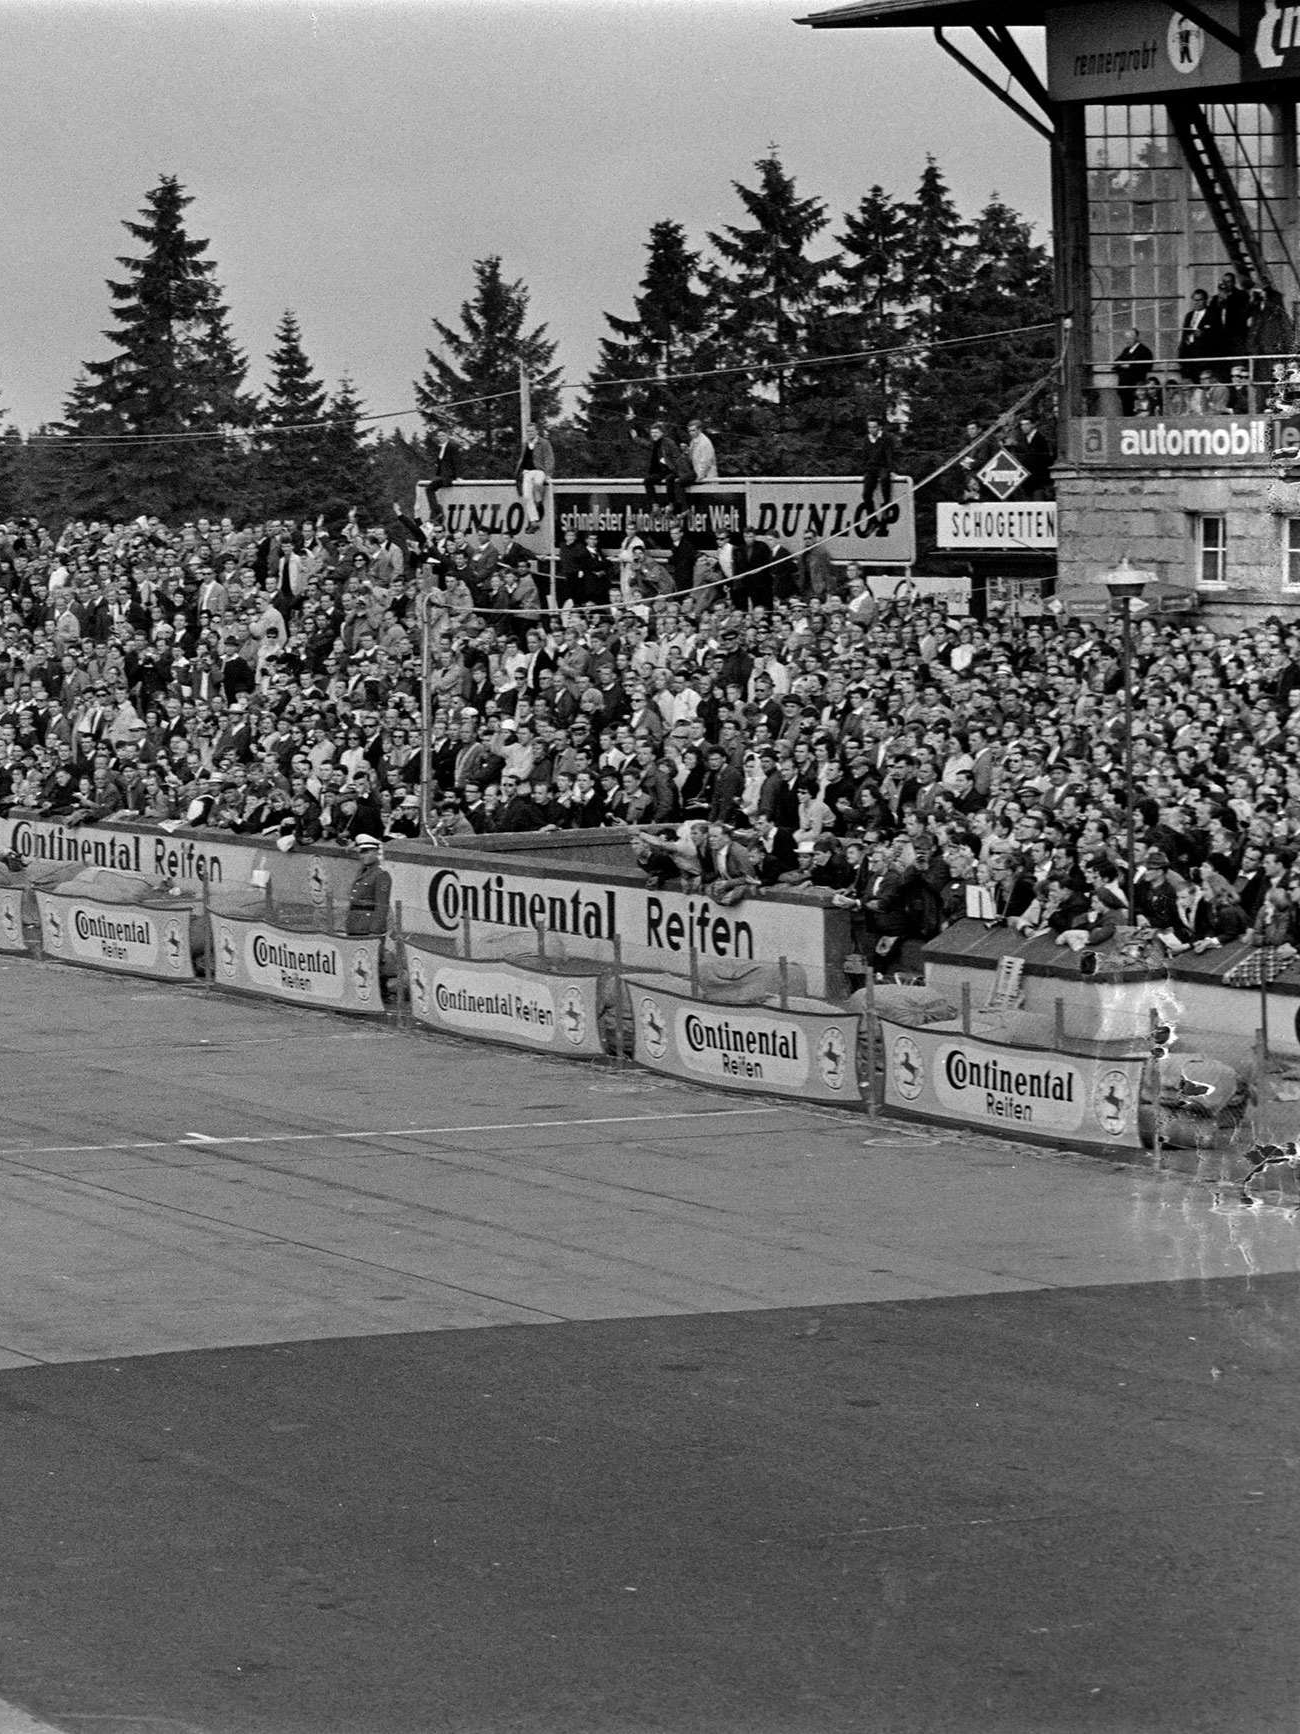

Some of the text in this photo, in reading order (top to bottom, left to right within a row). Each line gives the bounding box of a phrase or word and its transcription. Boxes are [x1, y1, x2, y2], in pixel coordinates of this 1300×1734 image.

[446, 502, 545, 538] UNLO
[708, 505, 739, 532] Welt
[753, 502, 900, 539] DUNLOP
[952, 511, 1055, 538] SCHOGETTEN
[11, 821, 223, 884] Continental Reifen
[75, 910, 151, 946] Continental
[428, 870, 754, 960] Continental Reifen
[252, 934, 337, 976] Continental
[281, 968, 313, 993] Reifen
[435, 984, 554, 1027] Continental Reifen
[685, 1013, 799, 1060] Continental
[722, 1053, 764, 1079] Reifen
[945, 1049, 1075, 1103] Continental
[986, 1092, 1033, 1122] Reifen
